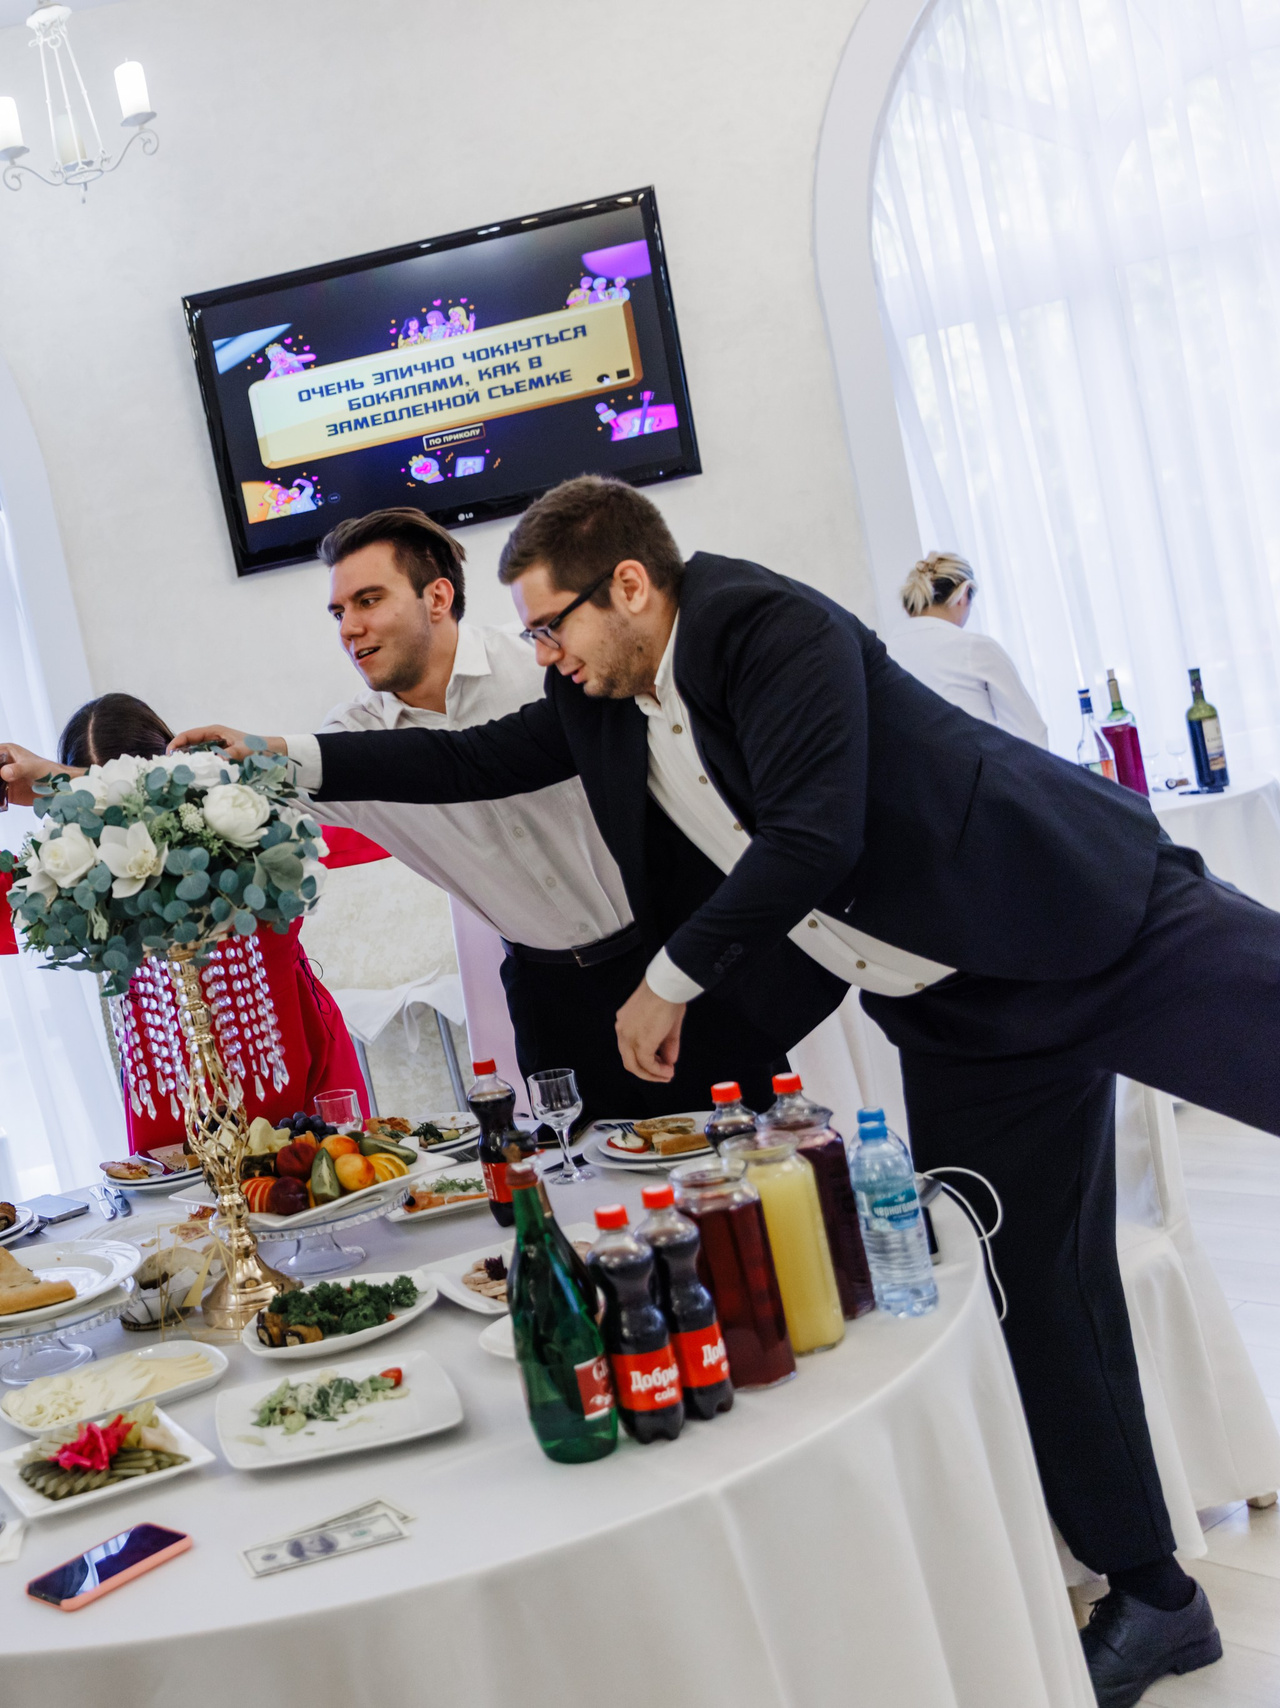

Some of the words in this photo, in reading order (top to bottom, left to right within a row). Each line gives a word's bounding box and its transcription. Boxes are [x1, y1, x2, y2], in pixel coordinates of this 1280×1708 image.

[297, 378, 365, 402] ОЧЕНЬ
[372, 355, 455, 386] ЭПИЧНО
[463, 325, 588, 363] ЧОКНУТЬСЯ
[347, 374, 470, 411] БОКАЛАМИ,
[478, 360, 521, 382] КАК
[528, 355, 543, 370] В
[325, 388, 480, 437] ЗАМЕДЛЕННОЙ
[487, 369, 573, 400] СЪЕМКЕ
[429, 437, 442, 446] ПО
[442, 428, 481, 443] ПРИКОЛУ
[654, 1386, 677, 1402] cola
